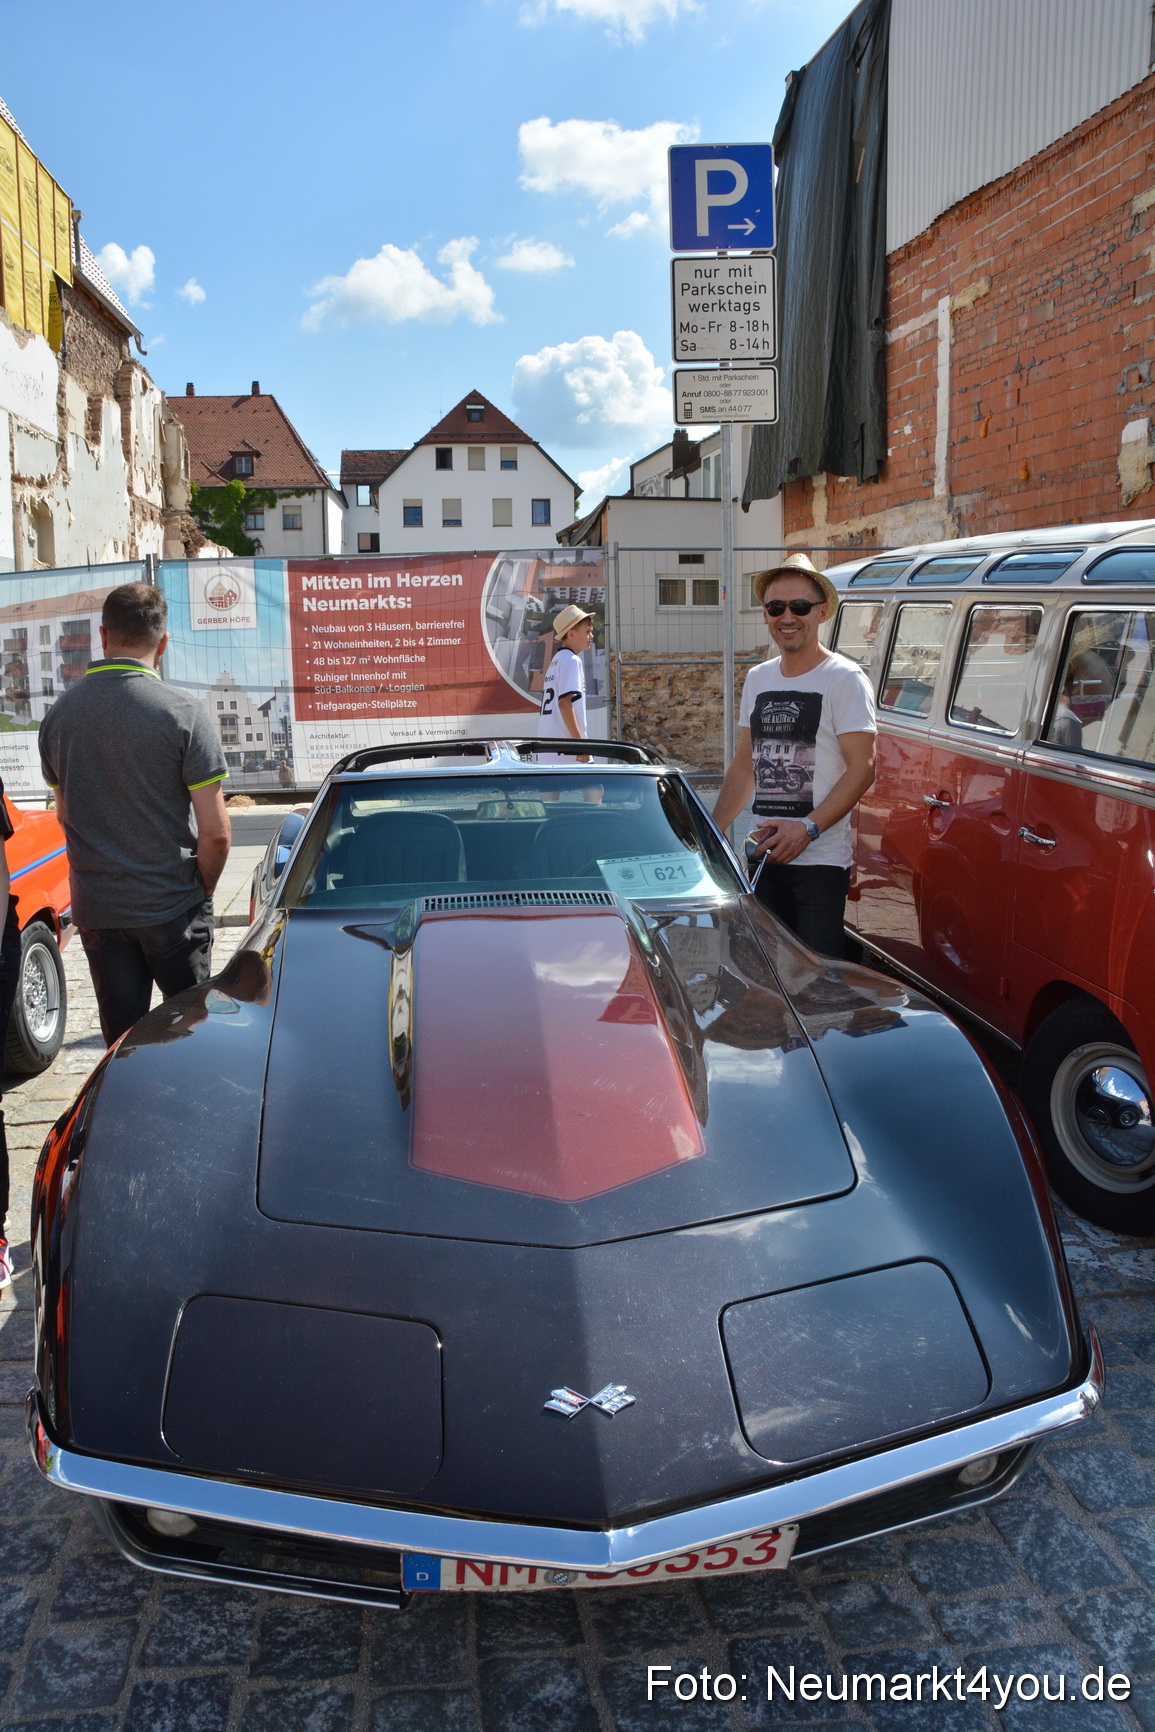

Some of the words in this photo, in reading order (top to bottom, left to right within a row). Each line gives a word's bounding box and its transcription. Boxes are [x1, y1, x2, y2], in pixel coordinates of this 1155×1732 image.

[695, 159, 748, 236] P
[695, 268, 720, 278] nur
[728, 264, 753, 278] mit
[681, 281, 767, 296] Parkschein
[688, 299, 761, 315] werktags
[680, 340, 697, 352] Sa
[698, 374, 710, 382] Std.
[724, 373, 759, 381] Parkschein
[301, 575, 363, 591] Mitten
[367, 573, 391, 589] im
[397, 573, 463, 588] Herzen
[303, 594, 412, 612] Neumarkts:
[197, 617, 228, 625] GERBER
[230, 615, 251, 623] HÖFE
[311, 624, 346, 633] Neubau
[367, 623, 373, 631] 3
[375, 621, 414, 632] Häusern,
[415, 620, 465, 630] barrierefrei
[312, 641, 322, 650] 21
[324, 639, 393, 649] Wohneinheiten,
[395, 638, 401, 647] 2
[403, 638, 416, 647] bis
[418, 637, 425, 646] 4
[427, 637, 461, 646] Zimmer
[313, 658, 325, 666] 48
[327, 657, 340, 665] bis
[342, 656, 355, 665] 127
[373, 654, 426, 664] Wohnfläche
[314, 673, 348, 684] Ruhiger
[351, 672, 390, 681] Innenhof
[392, 671, 407, 680] mit
[314, 684, 376, 695] Süd-Balkonen
[385, 683, 425, 693] -Loggien
[315, 700, 417, 711] Tiefgaragen-Stellplätze
[425, 728, 468, 737] Vermietung:
[654, 865, 688, 881] 621
[416, 1572, 429, 1581] D
